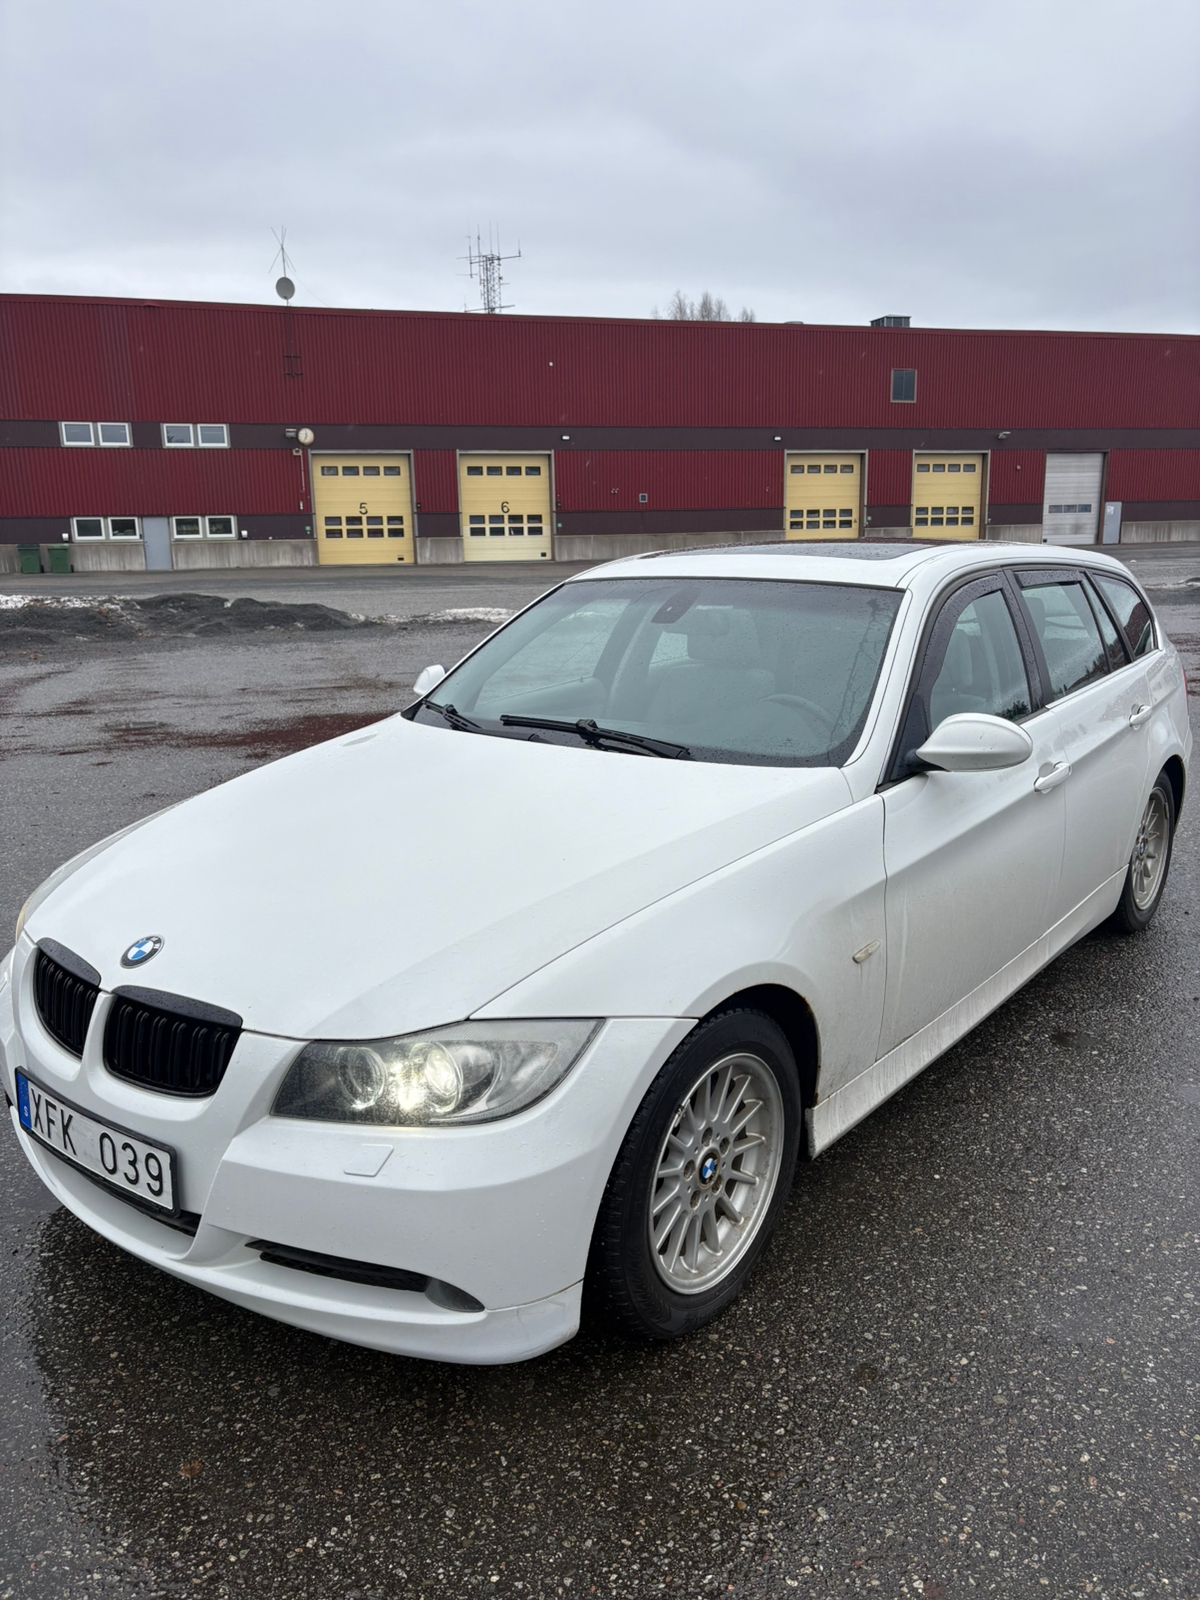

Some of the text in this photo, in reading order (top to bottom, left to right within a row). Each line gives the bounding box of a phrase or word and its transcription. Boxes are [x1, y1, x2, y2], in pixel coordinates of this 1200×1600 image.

[359, 502, 368, 515] 5
[501, 501, 510, 514] 6
[31, 1087, 163, 1197] XFK 039
